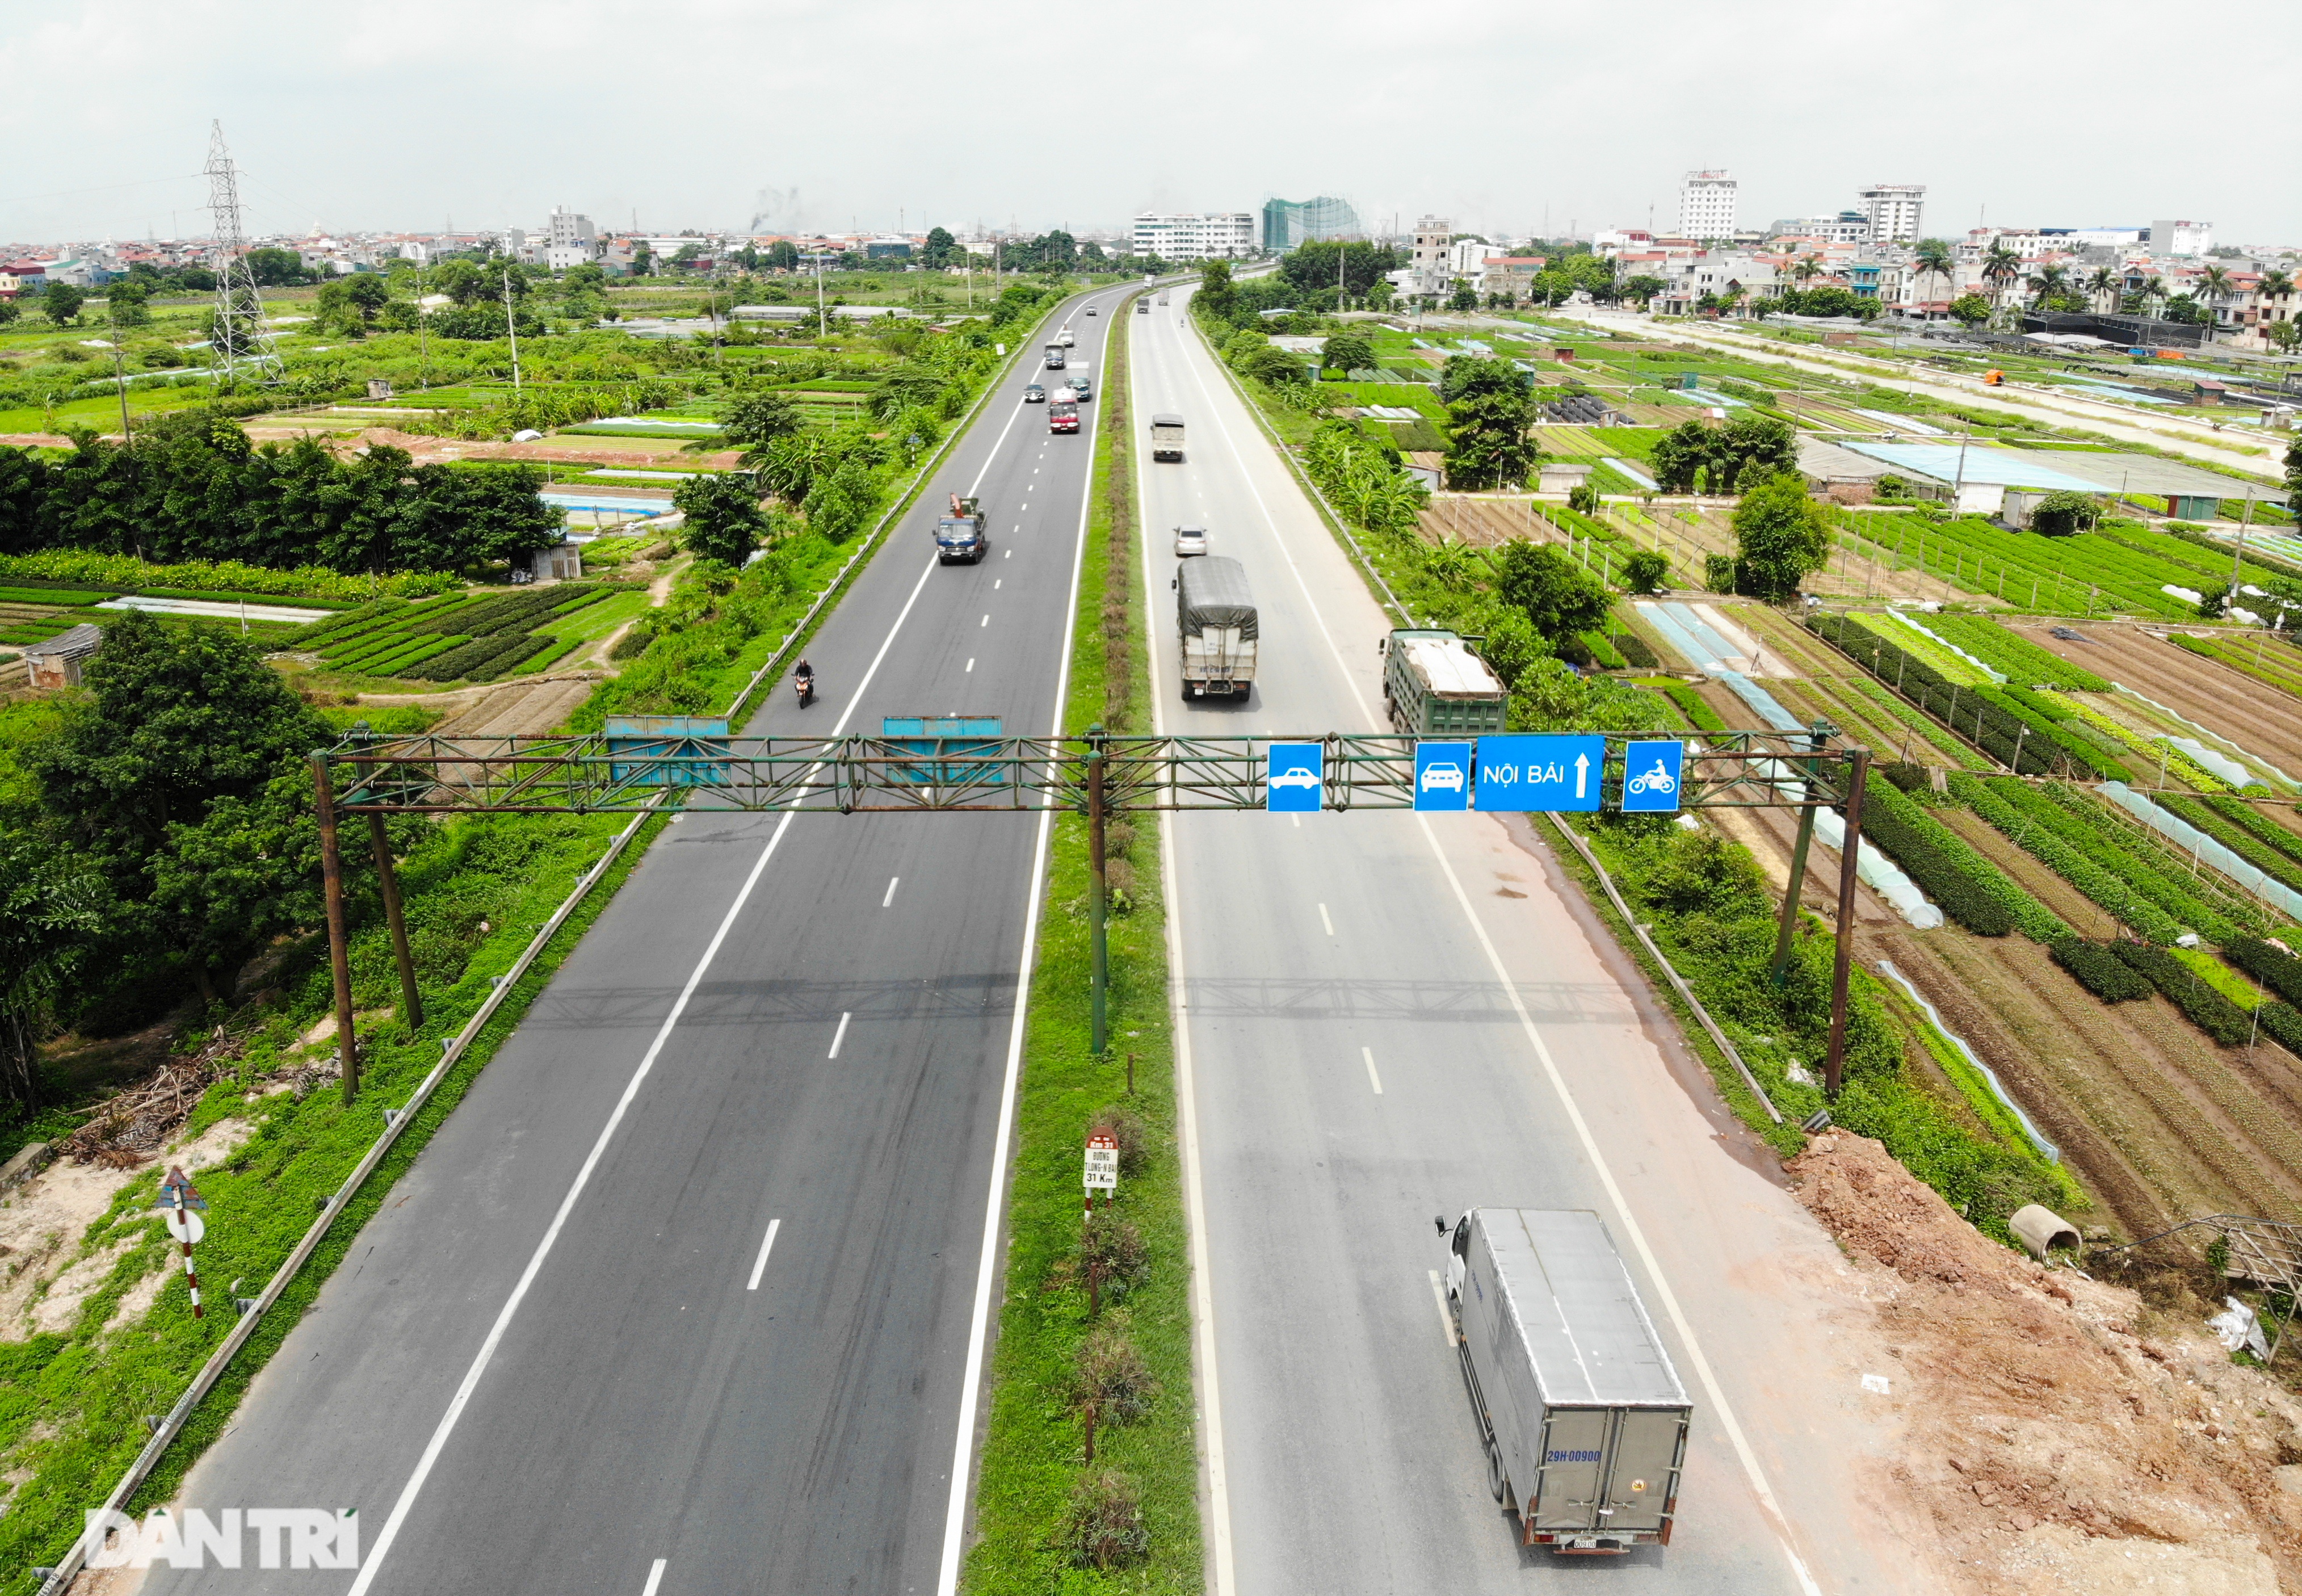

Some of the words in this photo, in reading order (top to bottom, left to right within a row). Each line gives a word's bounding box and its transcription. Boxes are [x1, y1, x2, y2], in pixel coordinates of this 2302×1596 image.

[1484, 763, 1519, 788] NỘI
[1087, 1173, 1096, 1182] 31
[1099, 1174, 1112, 1183] Km
[1547, 1450, 1602, 1462] 29H-00900
